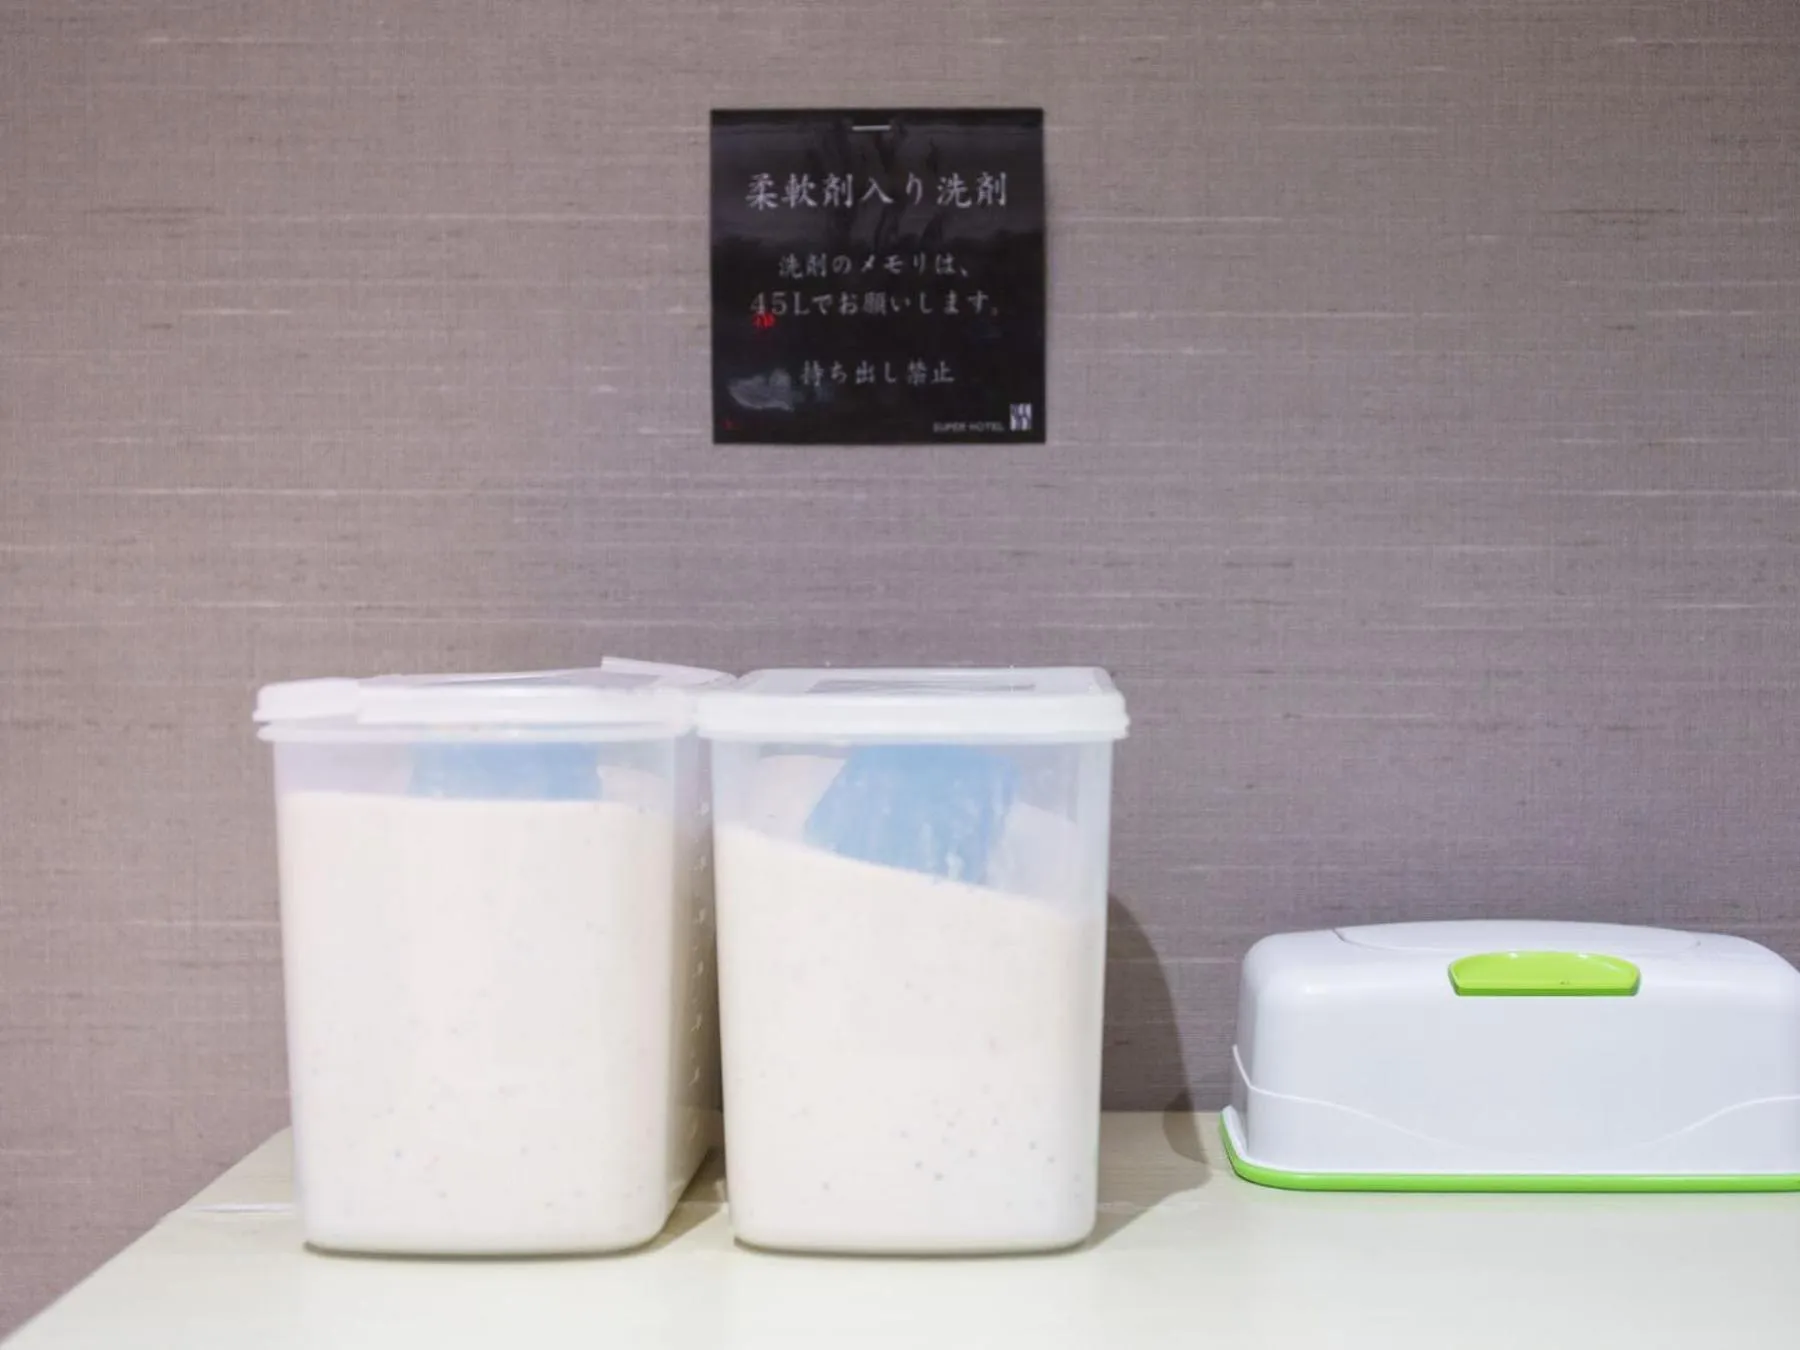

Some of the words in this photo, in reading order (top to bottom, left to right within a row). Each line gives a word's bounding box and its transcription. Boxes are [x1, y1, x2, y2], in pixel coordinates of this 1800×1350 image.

[746, 171, 1008, 210] 柔軟剤入り洗剤
[778, 253, 970, 278] 洗剤のメモリは、
[750, 291, 1000, 316] 45Lでお願いします。
[800, 360, 954, 387] 持ち出し禁止
[932, 422, 966, 433] SUPER
[969, 422, 1004, 433] HOTEL
